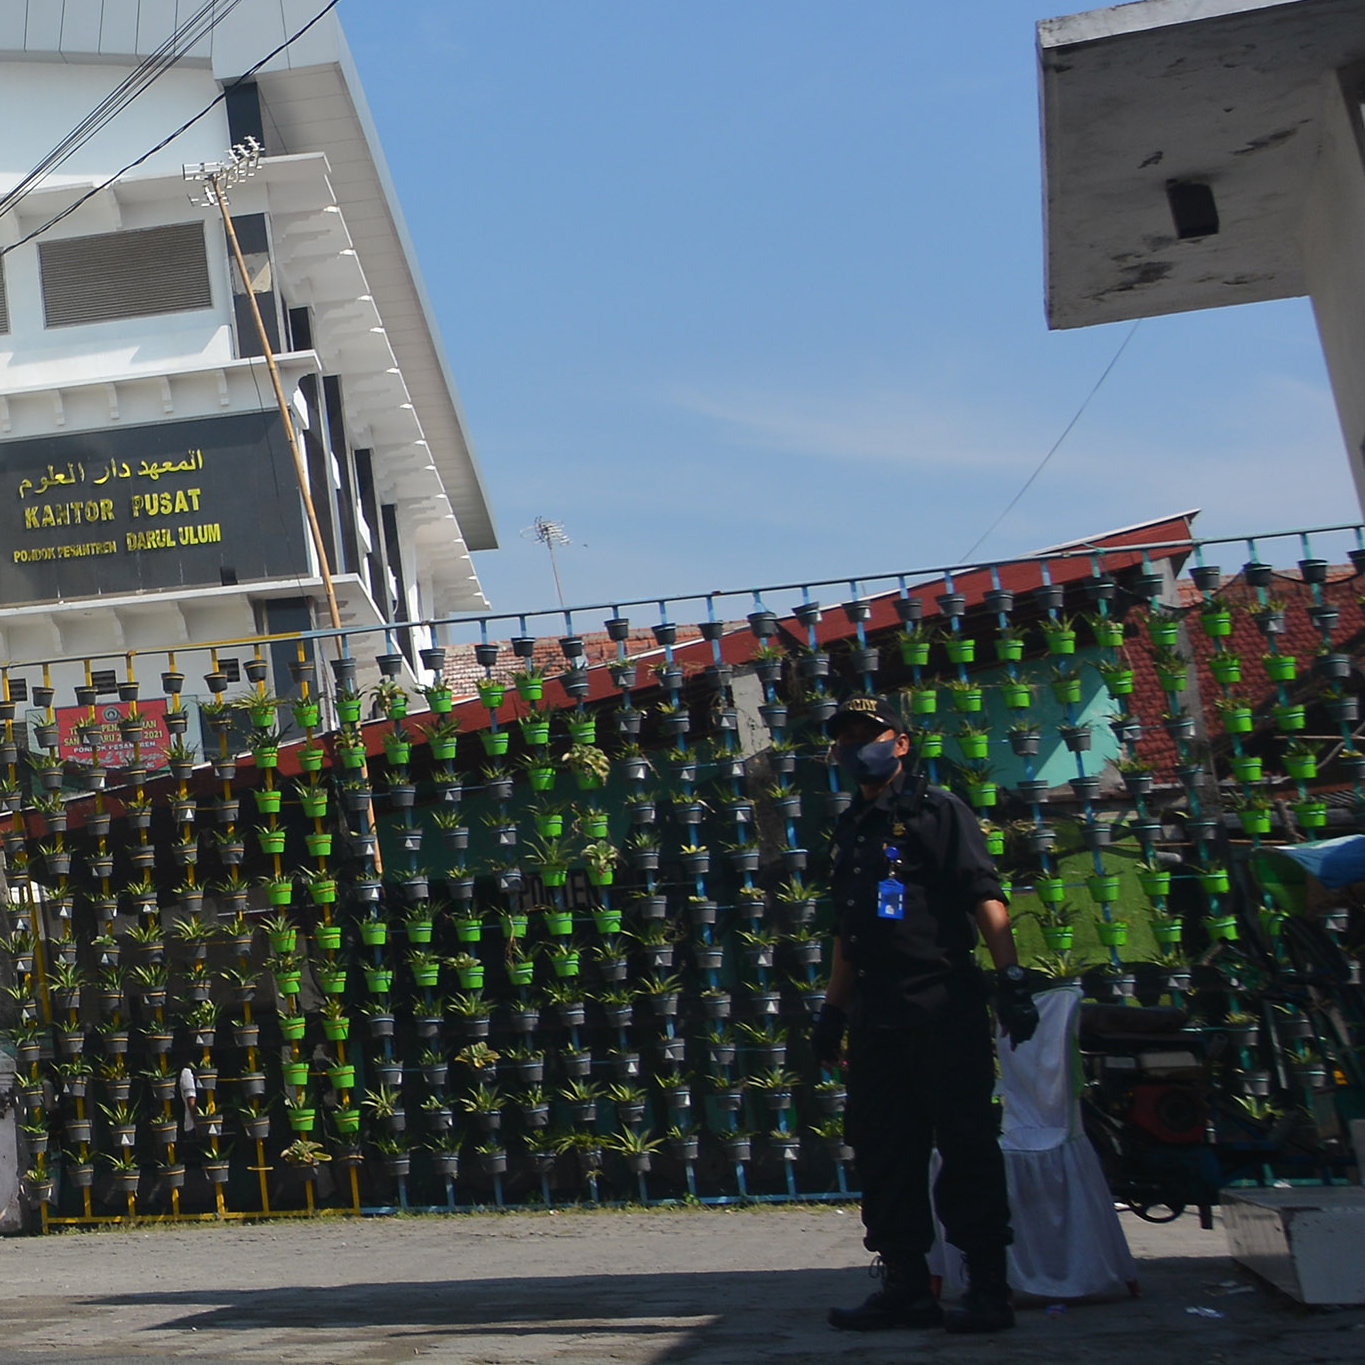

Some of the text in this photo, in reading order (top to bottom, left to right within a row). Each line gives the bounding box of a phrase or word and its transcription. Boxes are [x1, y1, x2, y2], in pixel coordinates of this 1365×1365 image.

[93, 457, 131, 484] دار
[24, 488, 201, 529] KANTOR PUSAT
[57, 540, 117, 558] PESANTREN
[126, 529, 176, 552] DARUL
[178, 523, 221, 546] ULUM
[109, 741, 156, 750] PESANREN
[144, 730, 163, 739] 2021
